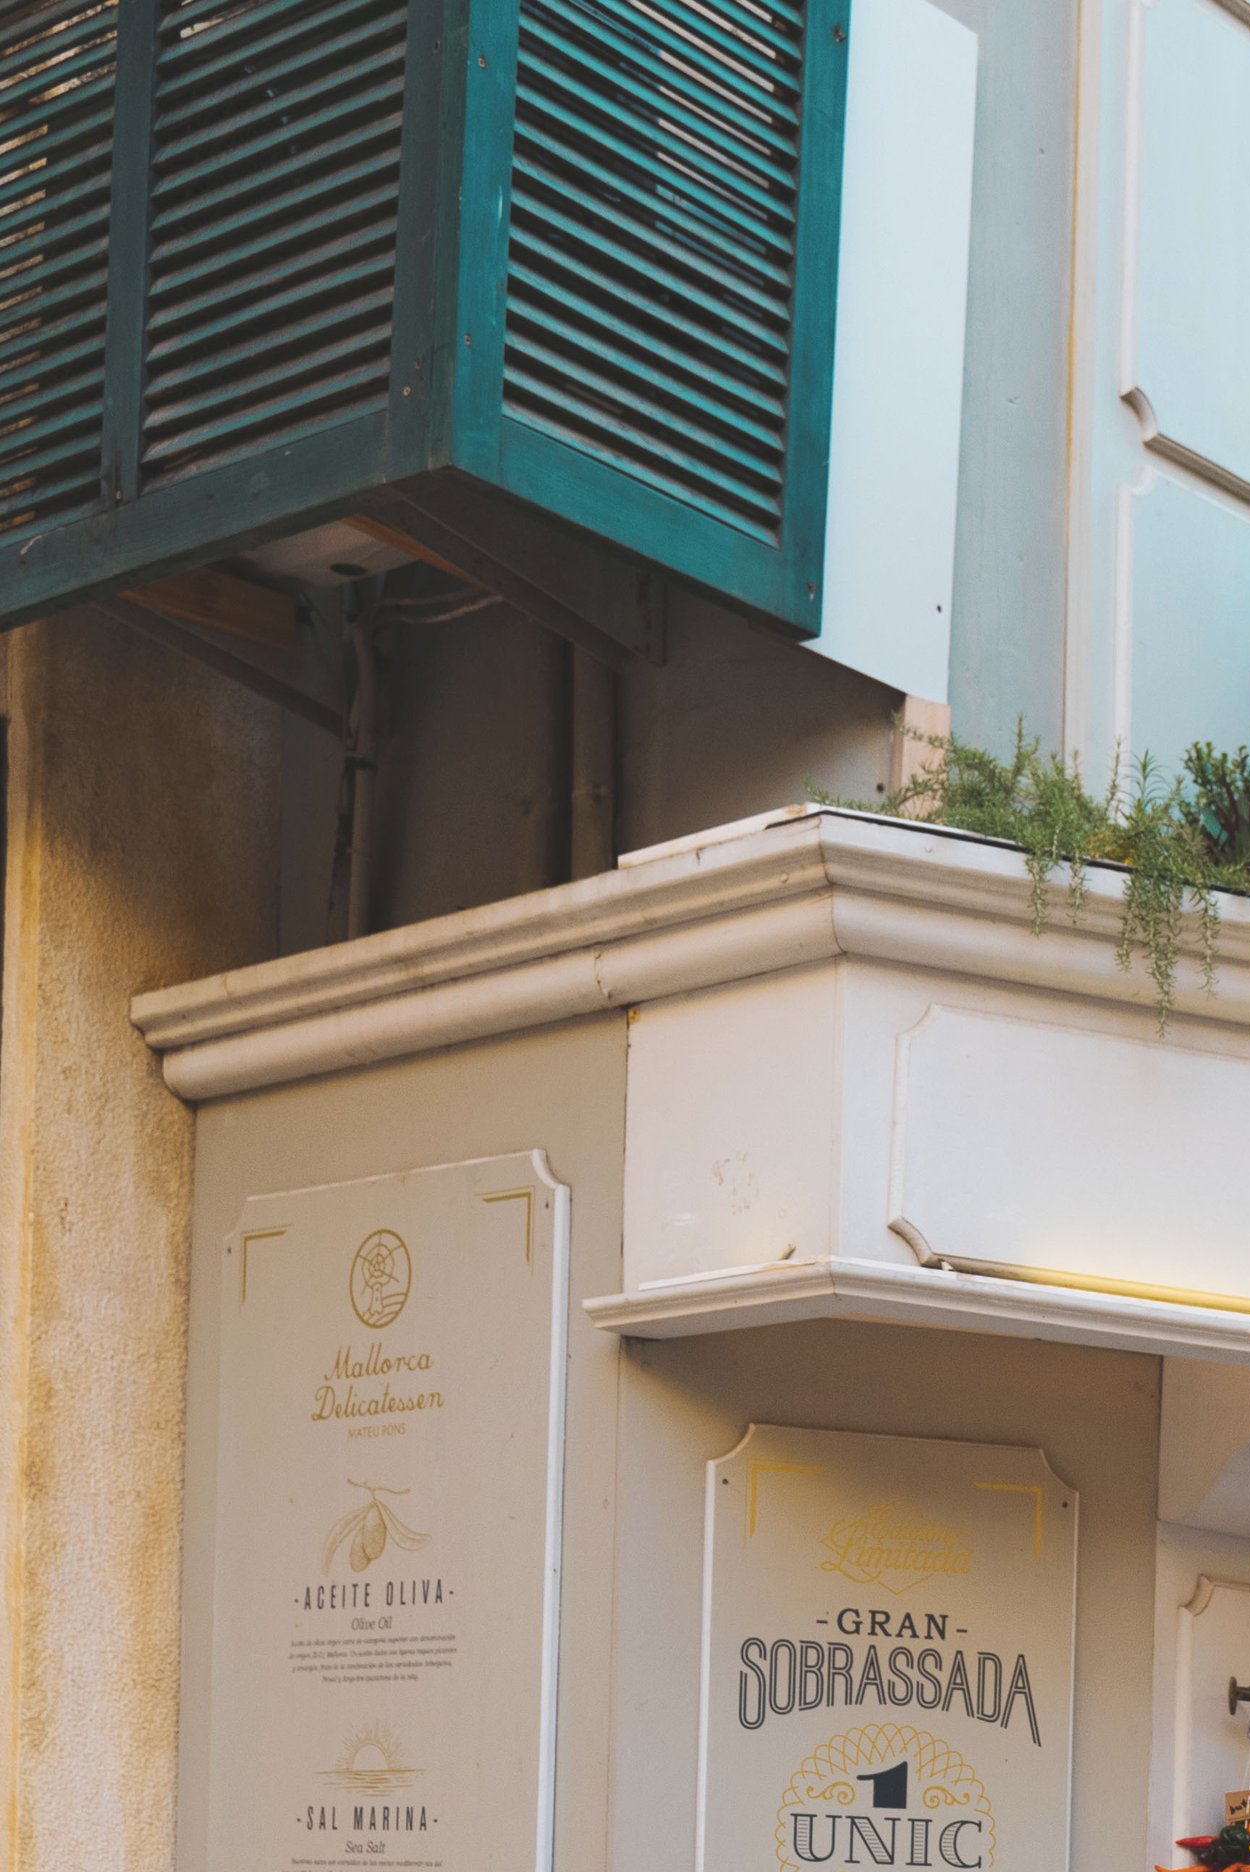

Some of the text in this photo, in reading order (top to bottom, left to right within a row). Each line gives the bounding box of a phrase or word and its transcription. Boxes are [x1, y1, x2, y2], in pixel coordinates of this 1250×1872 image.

[324, 1343, 433, 1381] Mallorca
[312, 1382, 444, 1421] Delicatessen
[304, 1579, 443, 1609] ACEITE OLIVA
[351, 1616, 392, 1631] Olive Oil
[837, 1608, 949, 1640] GRAN
[738, 1637, 1042, 1748] SOBRASSADA
[307, 1806, 427, 1831] SAL MARINA
[345, 1841, 386, 1854] Sea Salt
[790, 1812, 984, 1870] UNIC
